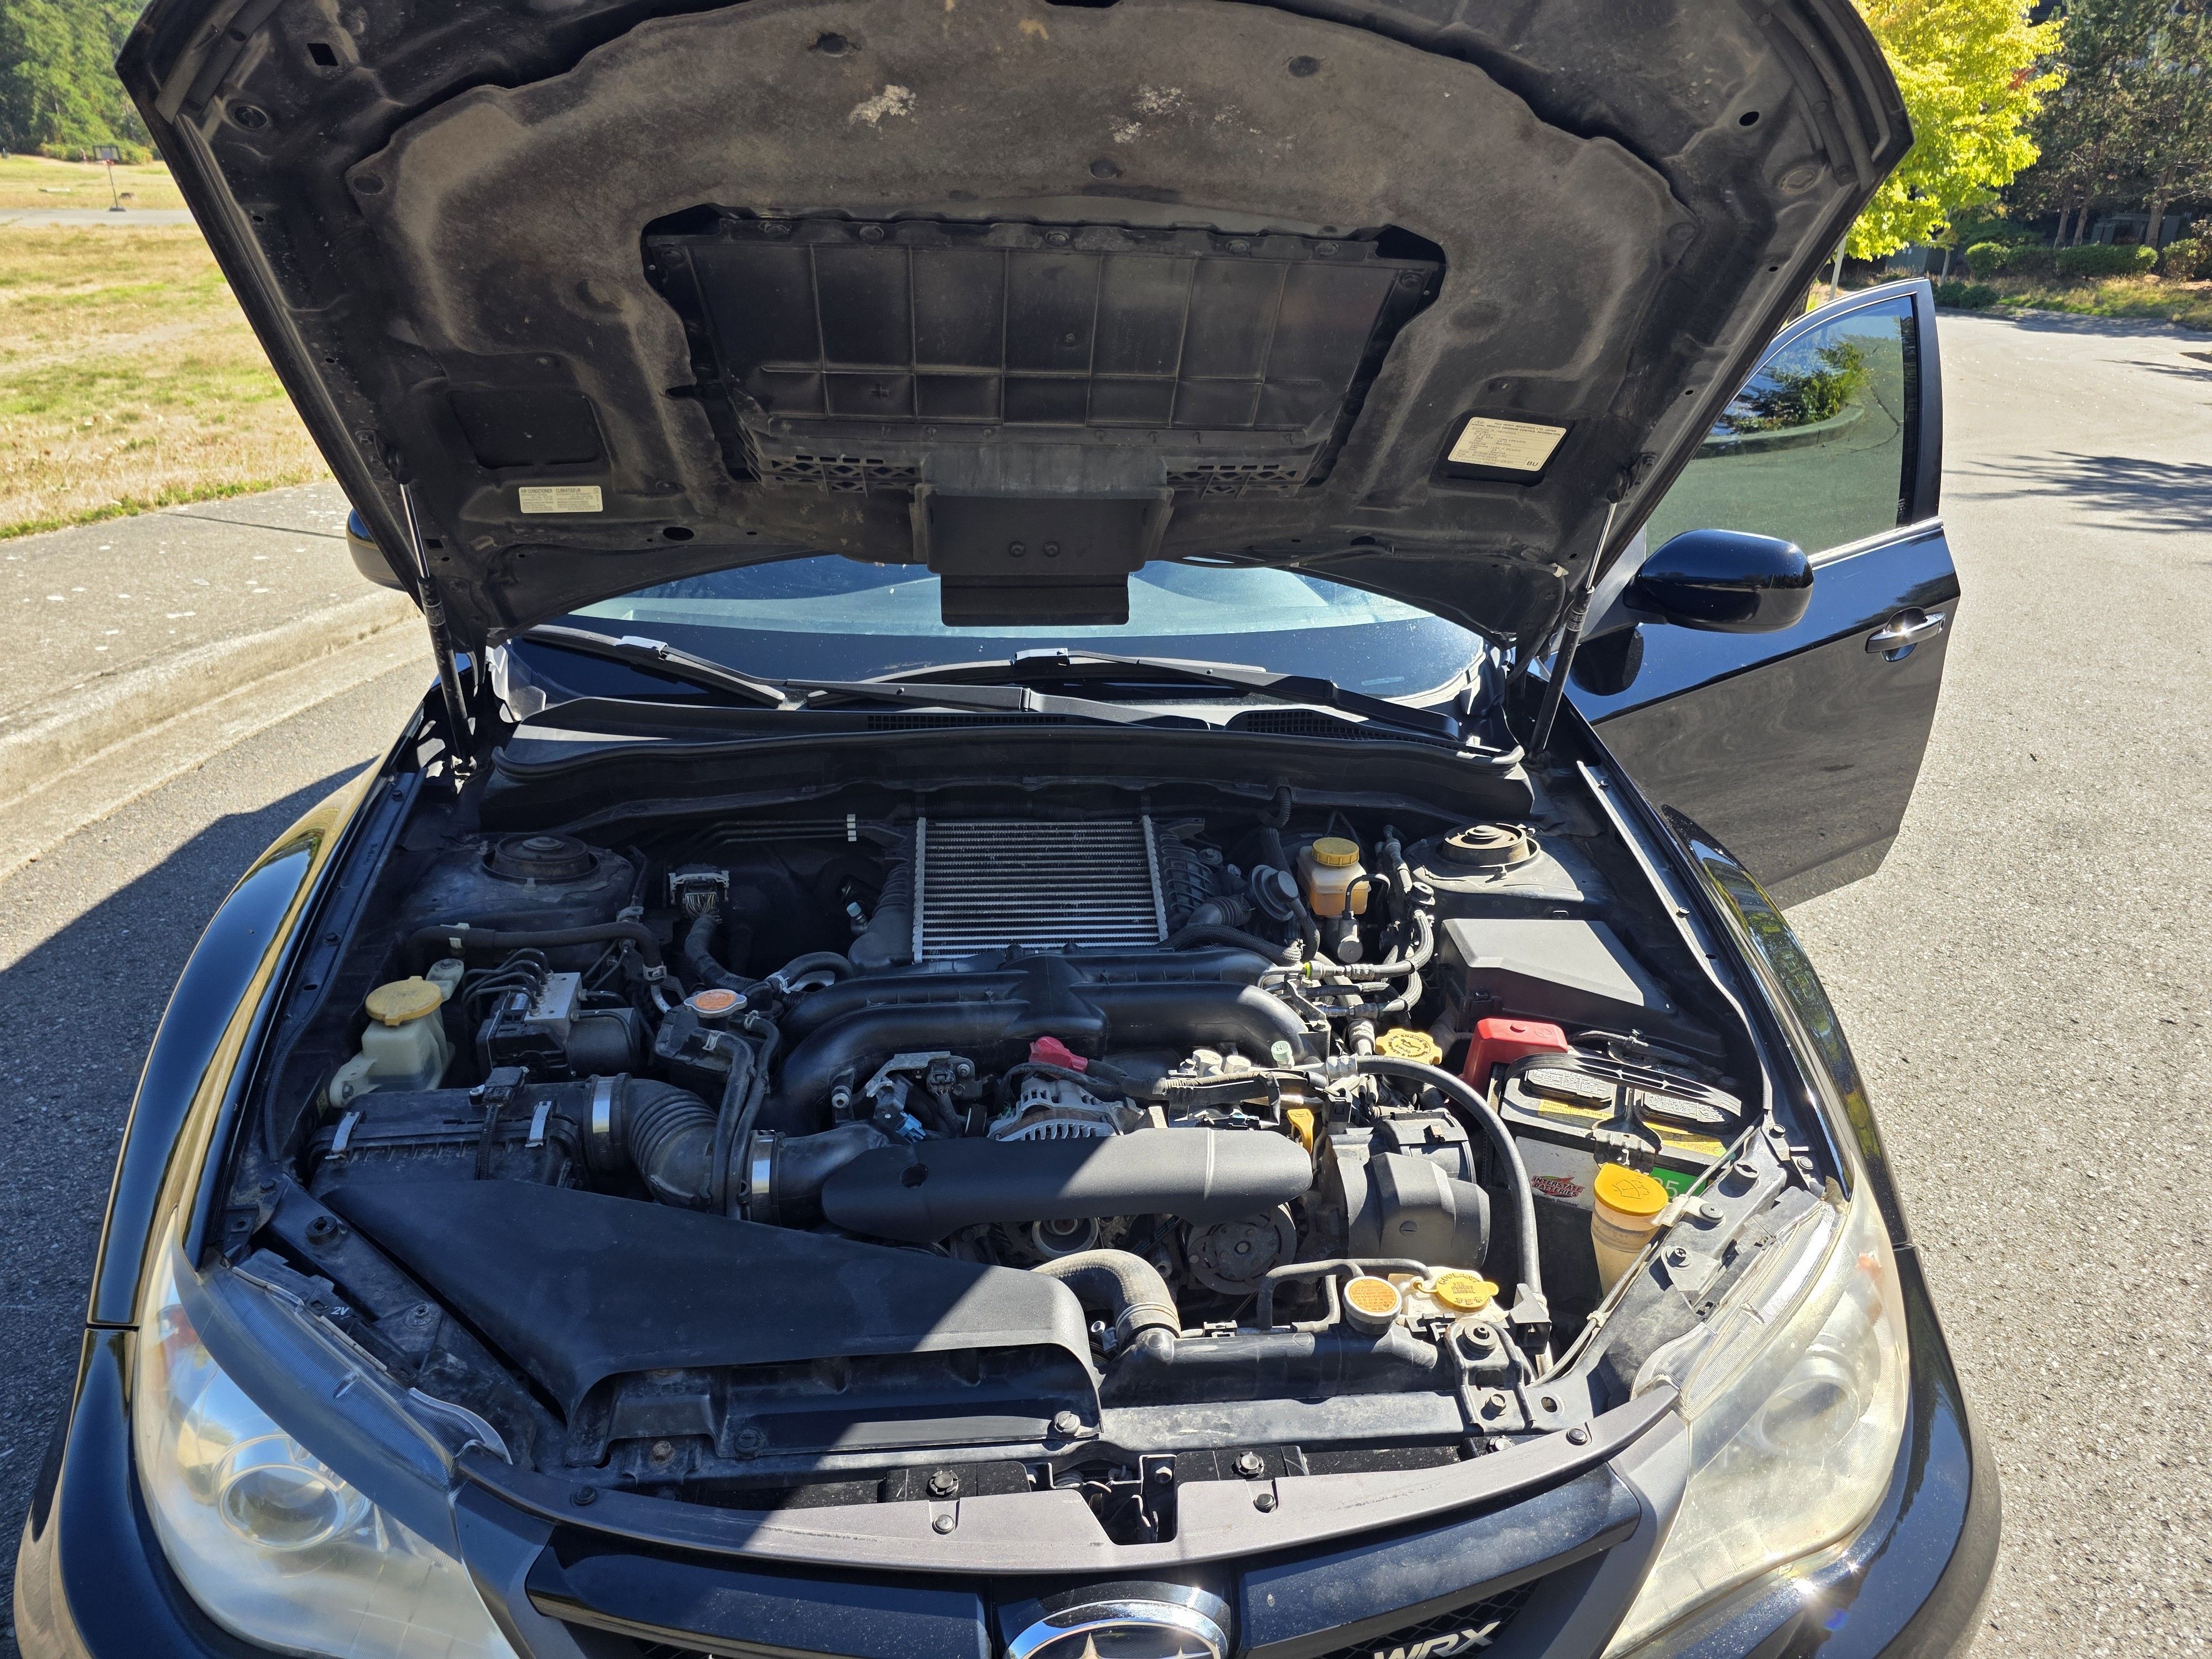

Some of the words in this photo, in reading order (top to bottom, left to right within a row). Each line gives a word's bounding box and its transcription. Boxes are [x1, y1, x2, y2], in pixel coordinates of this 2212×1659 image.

[1401, 1034, 1424, 1043] ENGINE
[1533, 1176, 1582, 1192] INTERSTATE
[1533, 1182, 1578, 1197] BATTERIES
[1438, 1273, 1482, 1284] COOLANT
[330, 1306, 350, 1316] 2V
[1374, 1620, 1501, 1659] WRX
